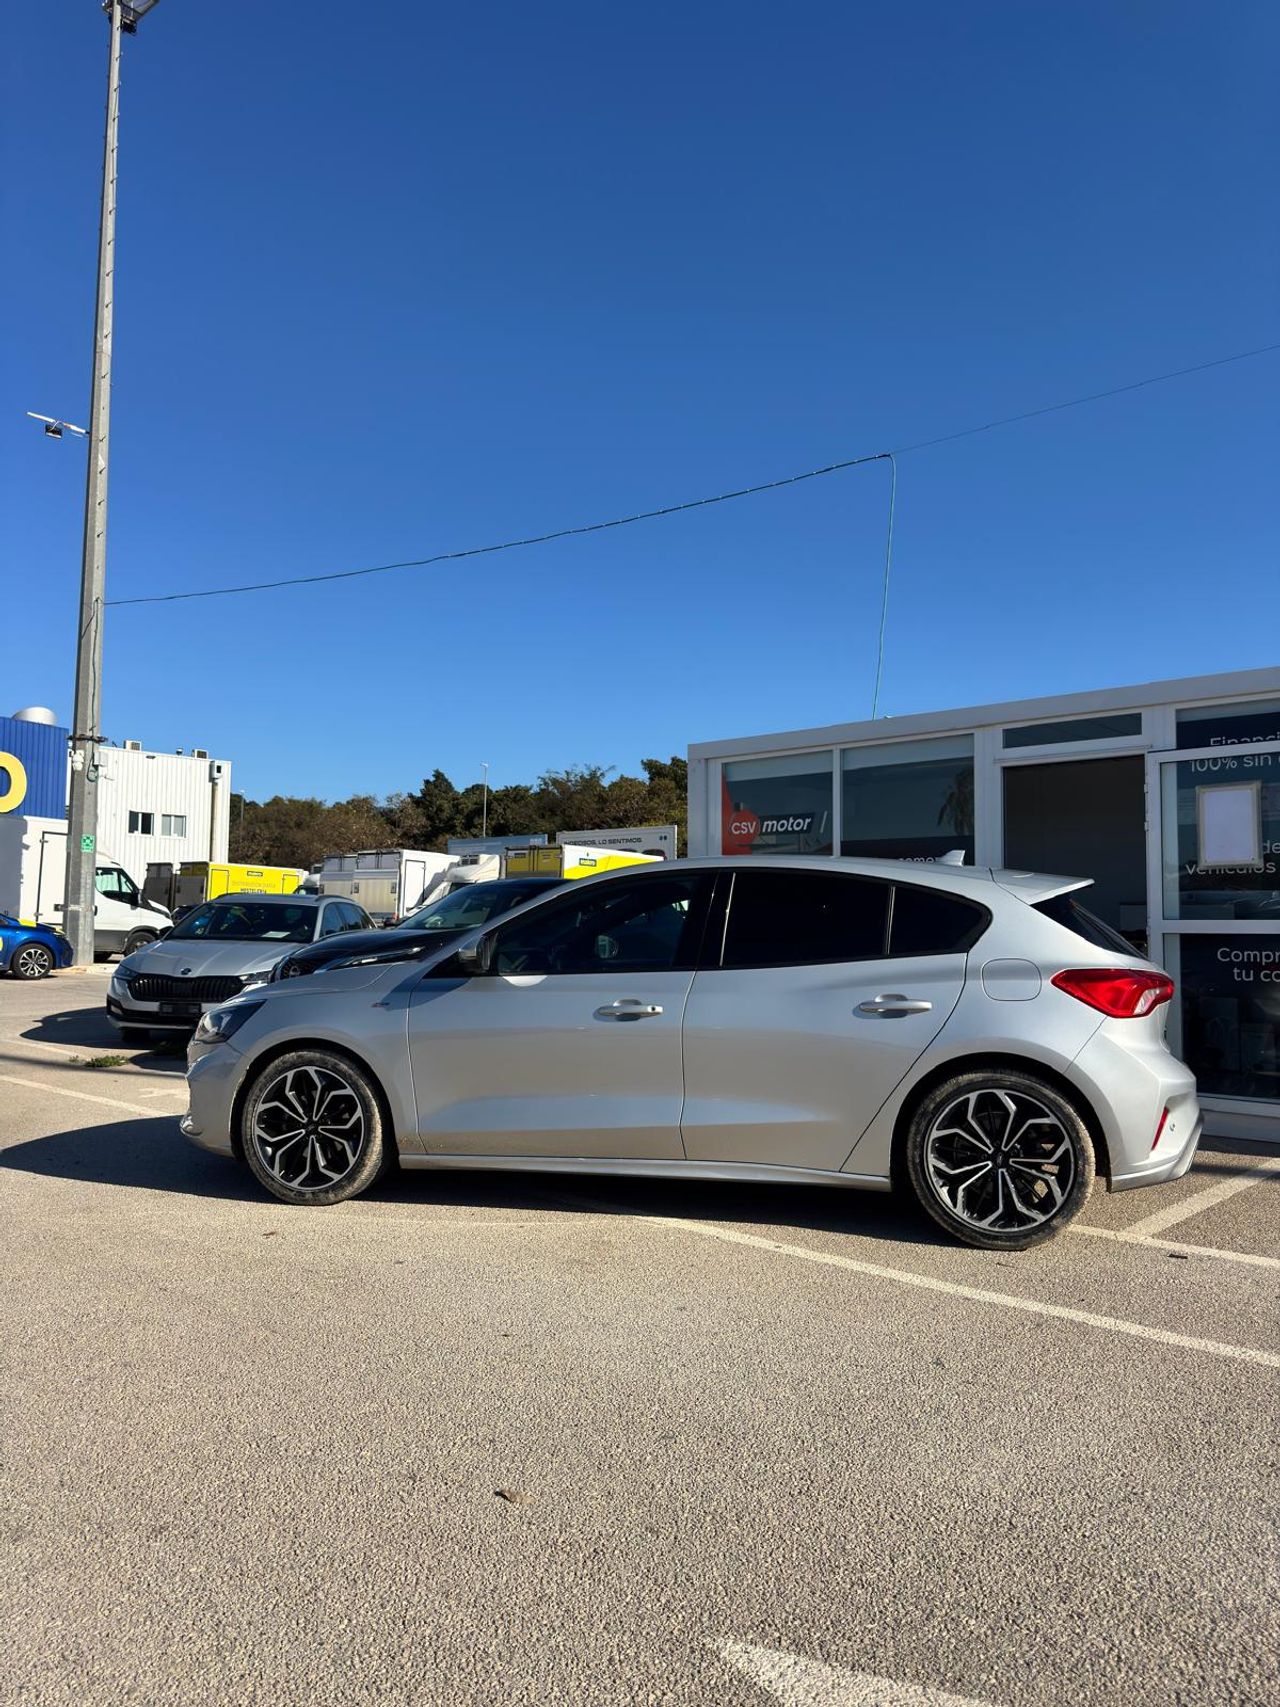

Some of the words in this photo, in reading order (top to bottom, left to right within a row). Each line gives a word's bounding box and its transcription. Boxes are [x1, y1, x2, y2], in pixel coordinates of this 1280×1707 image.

[731, 821, 757, 834] CSV
[762, 816, 812, 833] motor
[1233, 967, 1254, 981] tu
